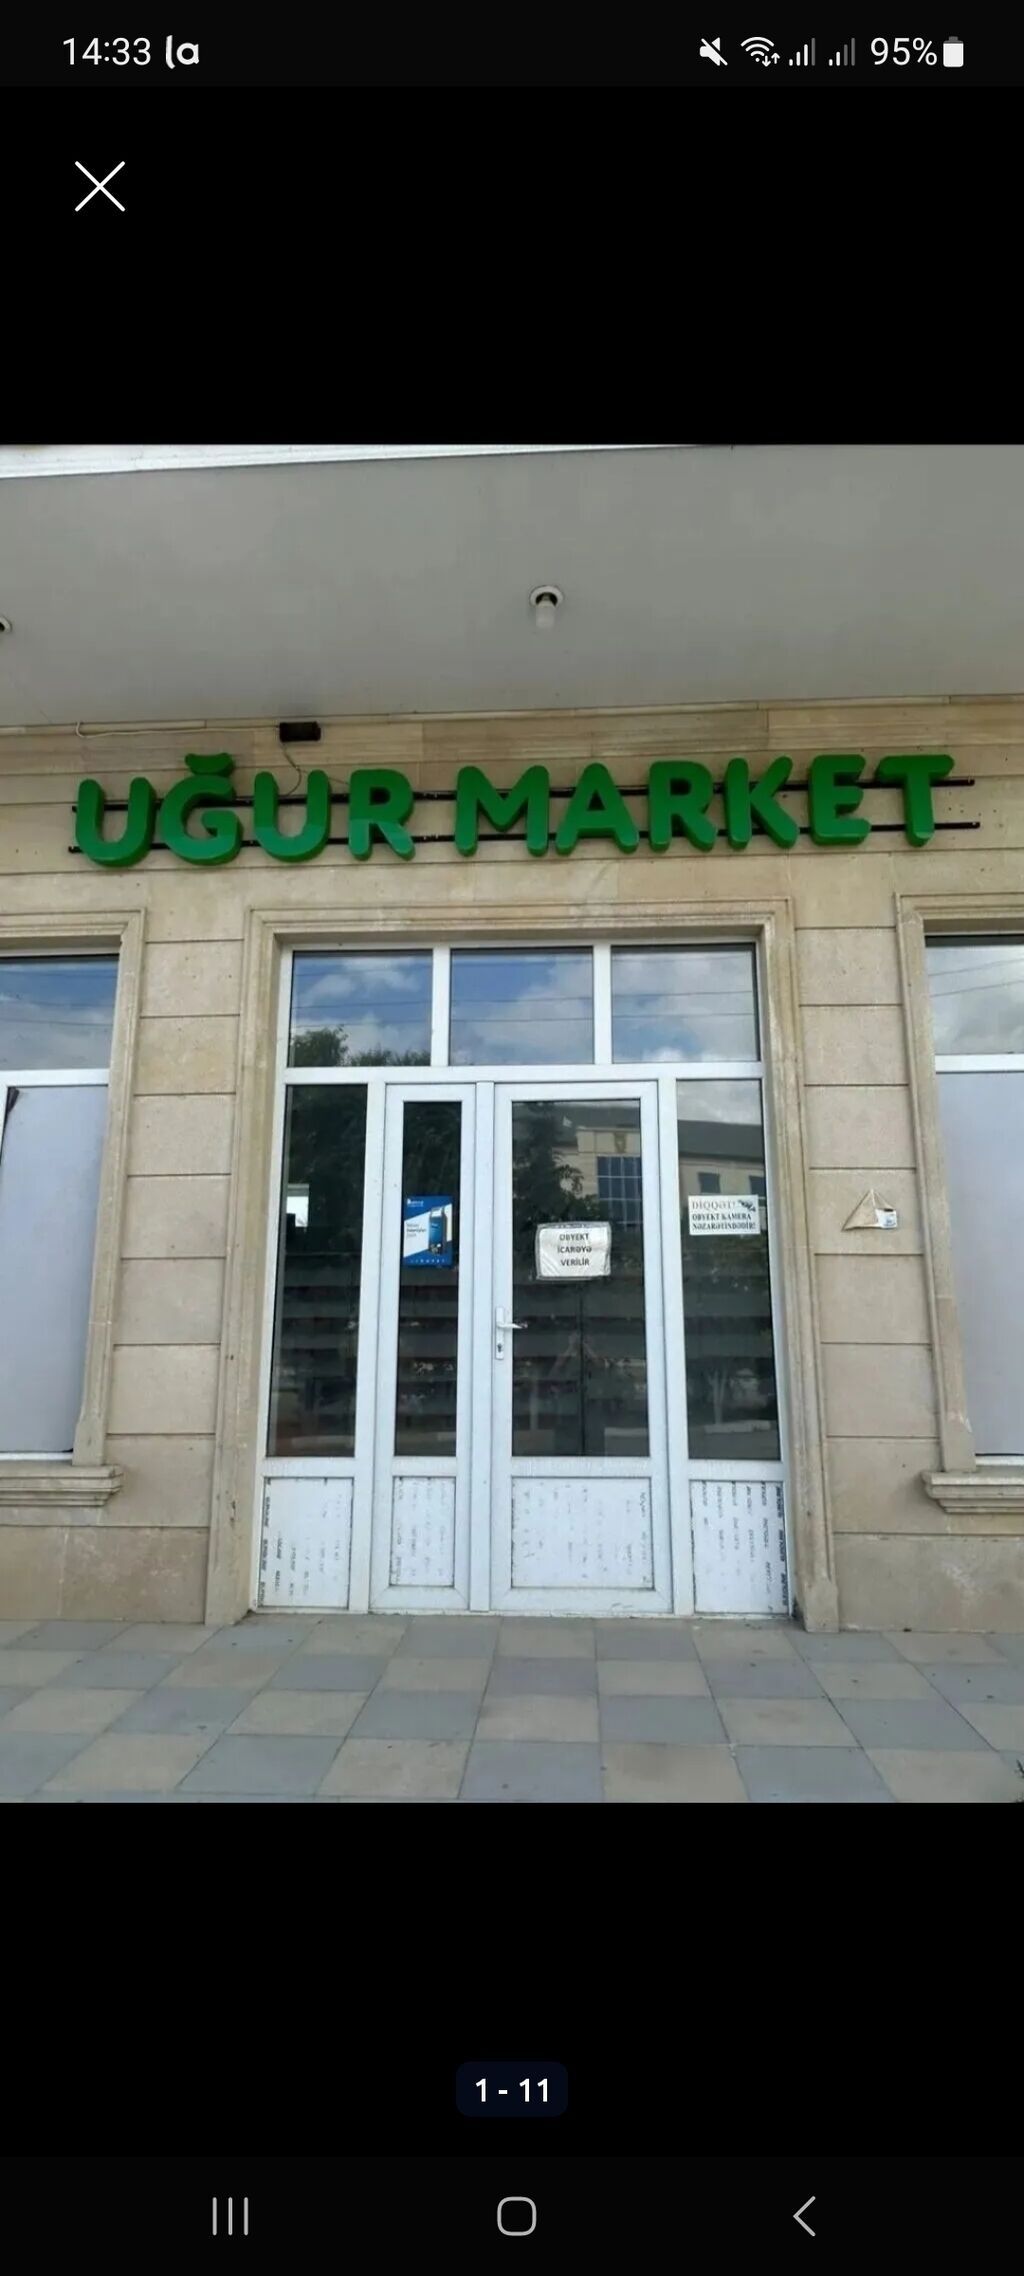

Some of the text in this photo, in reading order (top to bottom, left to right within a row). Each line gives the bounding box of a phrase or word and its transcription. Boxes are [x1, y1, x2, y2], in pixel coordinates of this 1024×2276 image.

[76, 753, 955, 868] UĞUR MARKET
[721, 1212, 752, 1221] KAMERA
[559, 1233, 590, 1241] OBYEKT
[560, 1257, 590, 1267] VERİLİR
